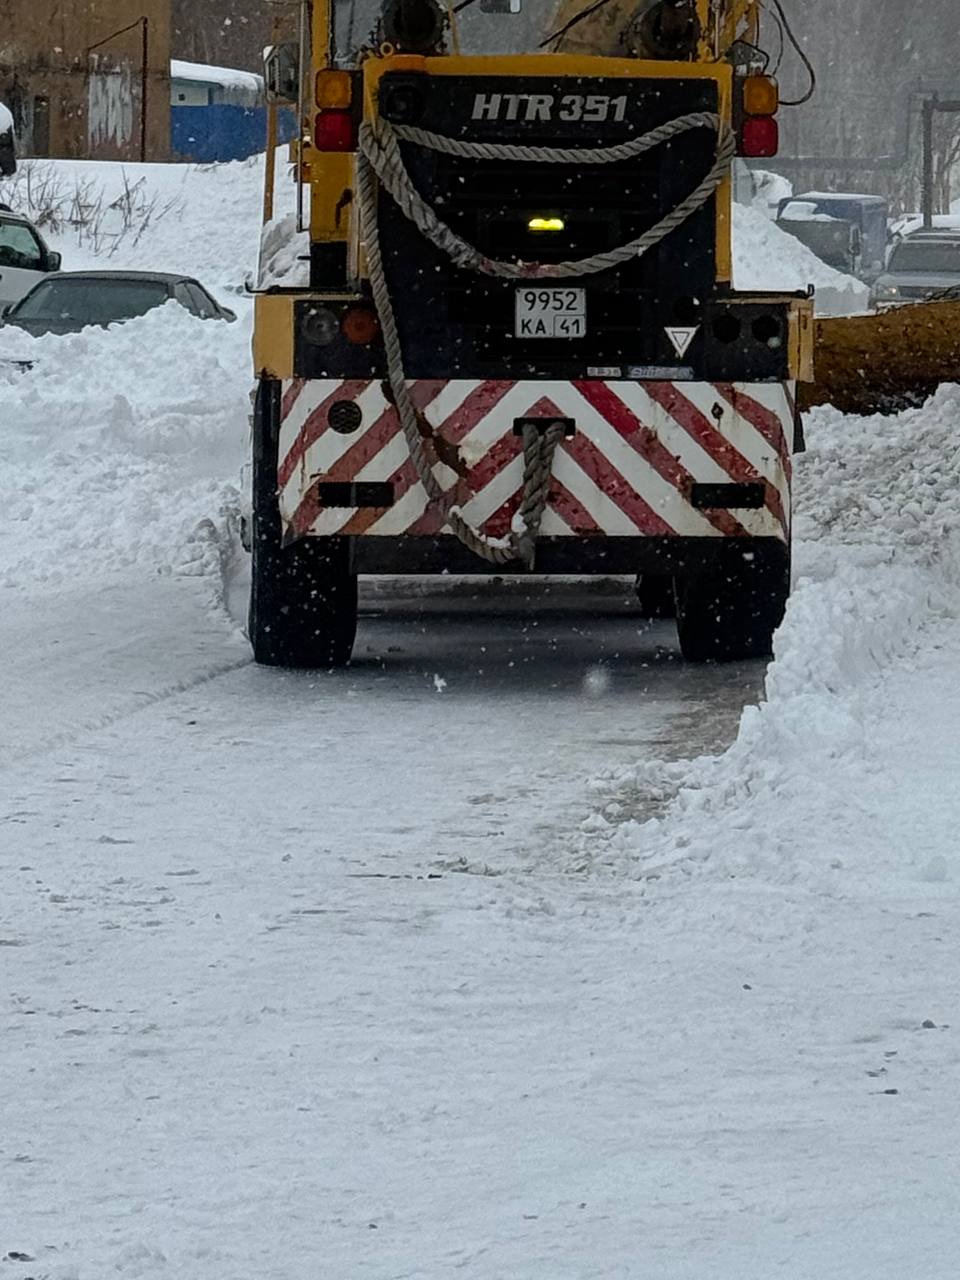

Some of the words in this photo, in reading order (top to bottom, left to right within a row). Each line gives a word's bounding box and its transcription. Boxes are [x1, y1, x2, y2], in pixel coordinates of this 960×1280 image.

[471, 94, 554, 120] HTR
[559, 95, 627, 121] 351
[524, 291, 578, 311] 9952
[560, 318, 580, 334] 41
